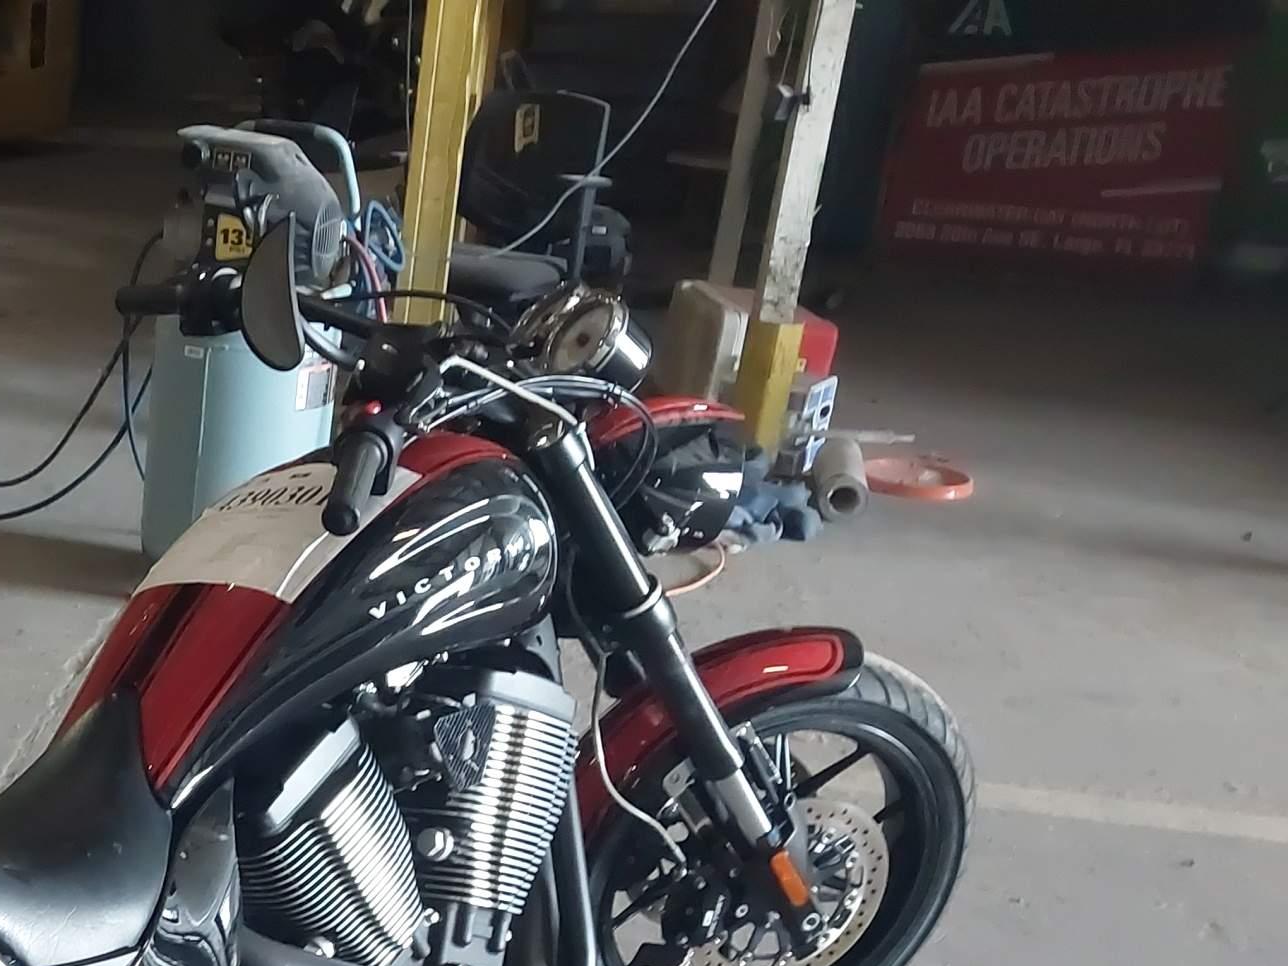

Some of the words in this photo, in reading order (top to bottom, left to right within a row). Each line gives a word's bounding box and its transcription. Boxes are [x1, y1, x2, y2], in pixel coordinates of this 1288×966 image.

[925, 84, 983, 128] IAA
[993, 69, 1228, 123] CATASTROPHE
[961, 120, 1168, 174] OPERATIONS
